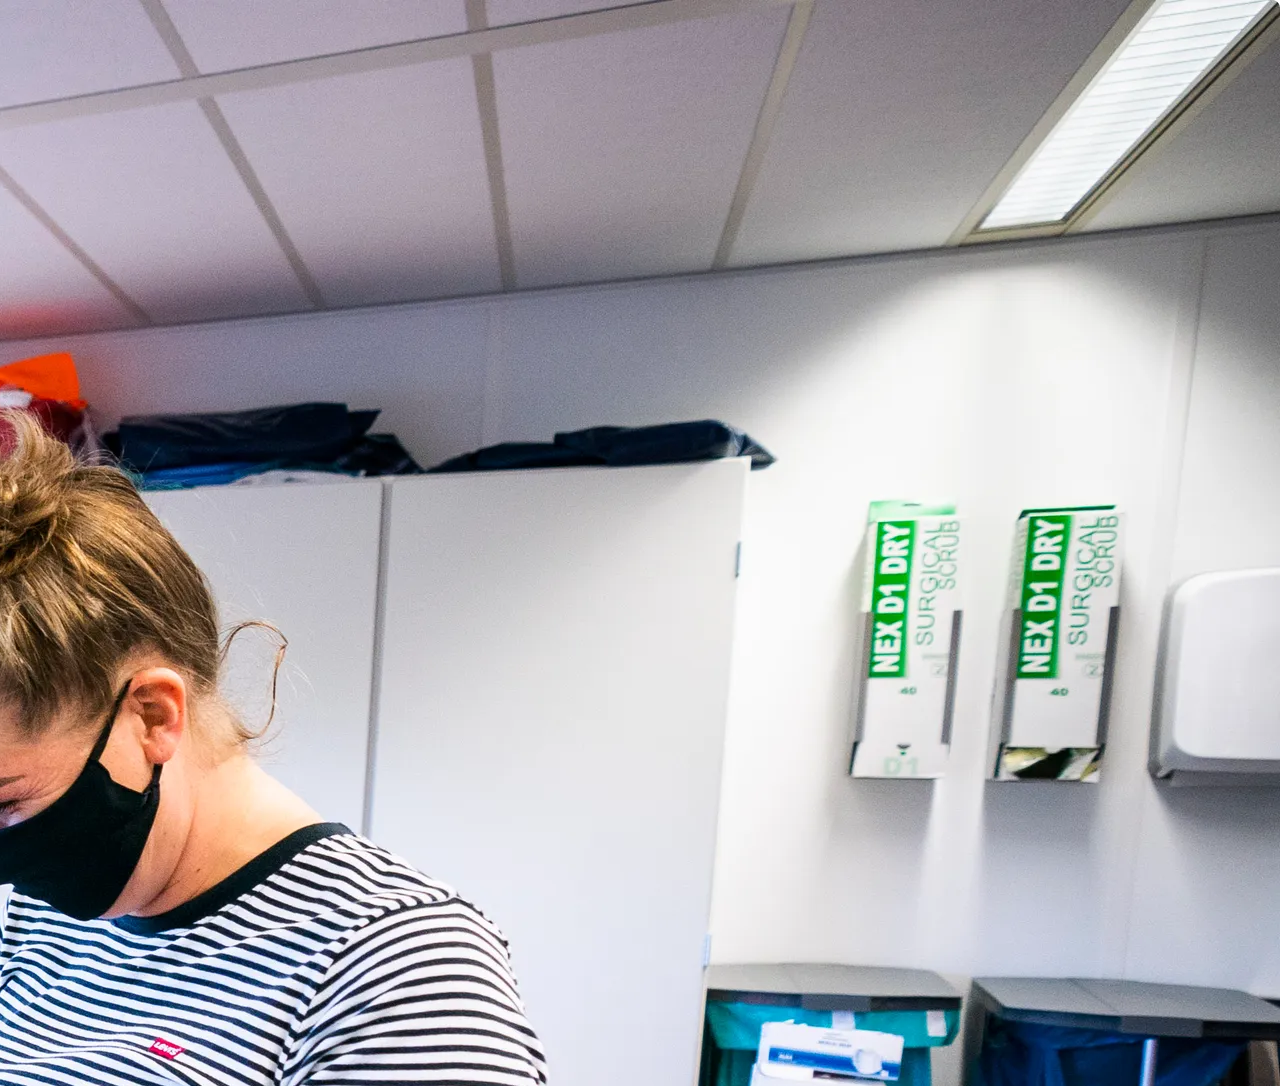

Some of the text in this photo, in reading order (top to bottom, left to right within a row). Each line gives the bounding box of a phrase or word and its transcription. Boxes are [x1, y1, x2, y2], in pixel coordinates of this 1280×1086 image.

[871, 523, 911, 672] NEX D1 DRY
[915, 522, 942, 645] SURGICAL
[939, 520, 960, 589] SCRUB
[1021, 519, 1064, 672] NEX D1 DRY
[1067, 517, 1099, 645] SURGICAL
[1094, 516, 1119, 588] SCRUB
